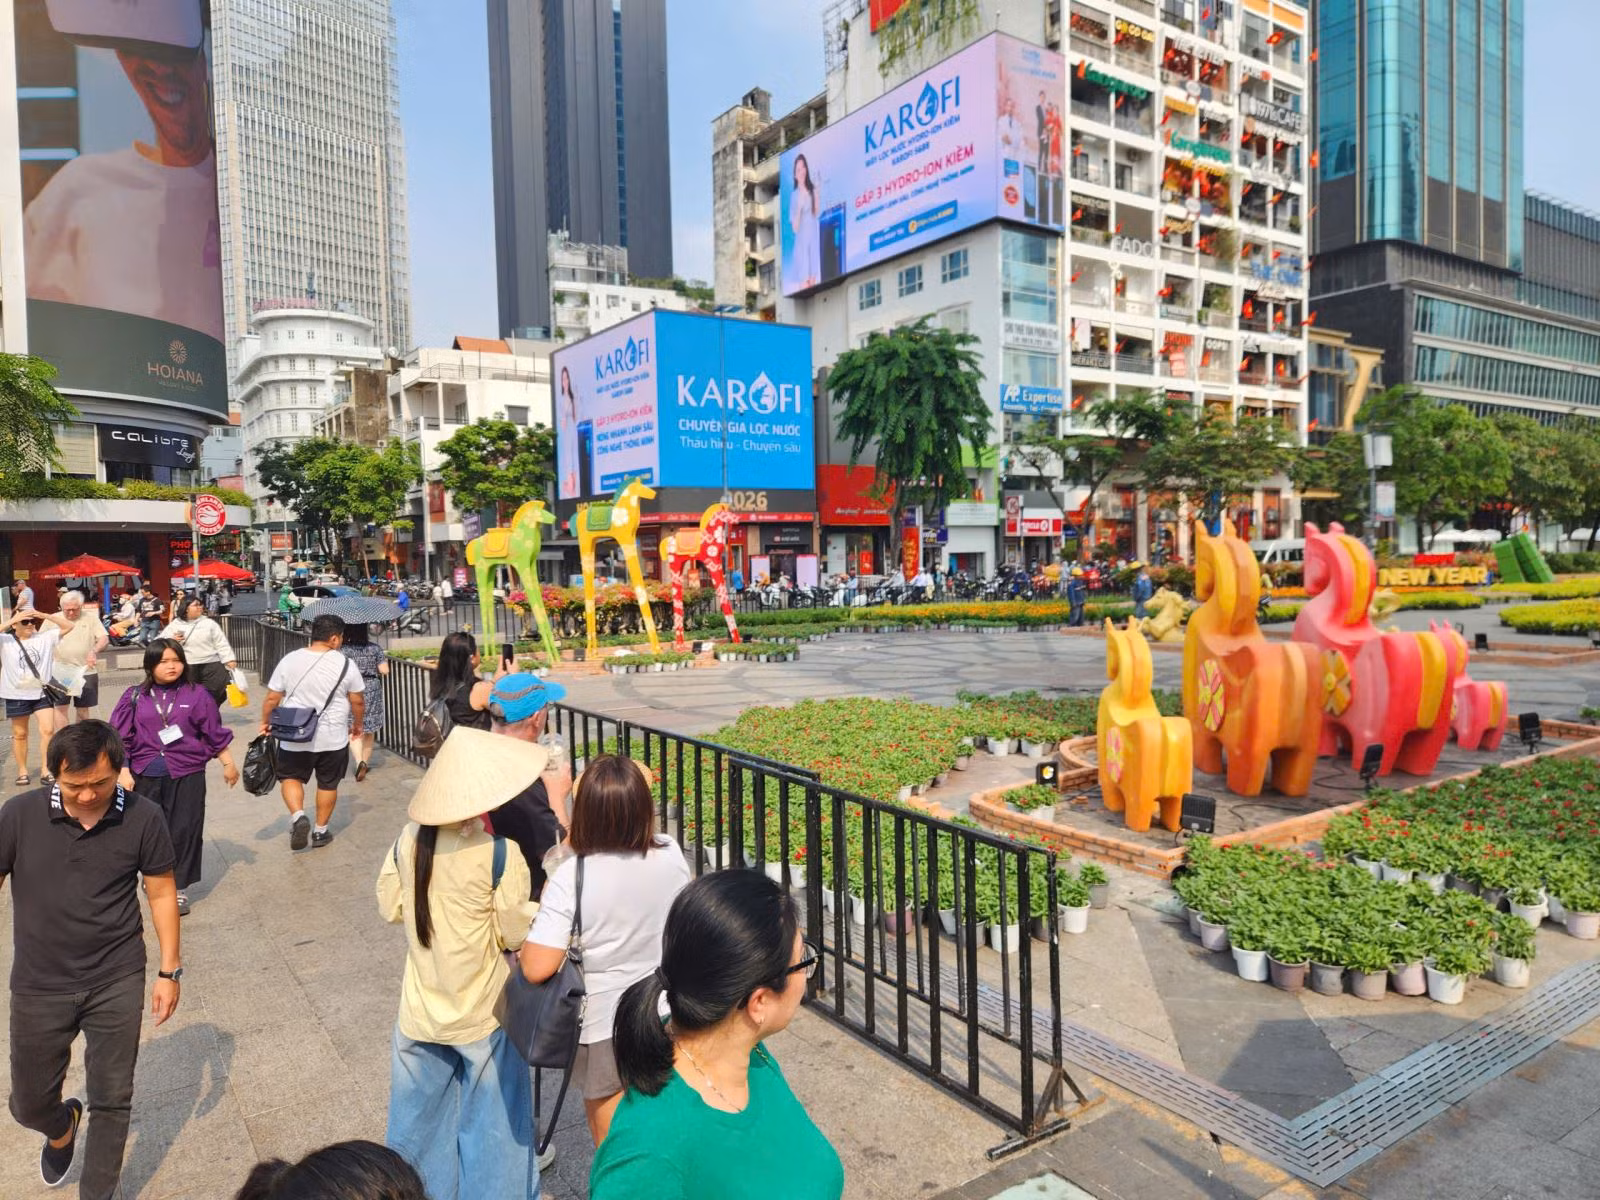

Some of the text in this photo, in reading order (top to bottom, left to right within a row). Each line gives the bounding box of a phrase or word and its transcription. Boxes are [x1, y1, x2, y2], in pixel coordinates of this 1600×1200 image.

[864, 75, 961, 154] KAROFI
[877, 186, 883, 199] 3
[885, 160, 943, 197] HYDRO-ION
[147, 361, 204, 386] HOIANA
[595, 336, 649, 381] KAROFI
[677, 370, 801, 415] KAROFI
[727, 421, 747, 434] GIA
[1379, 565, 1488, 586] NEW YEAR
